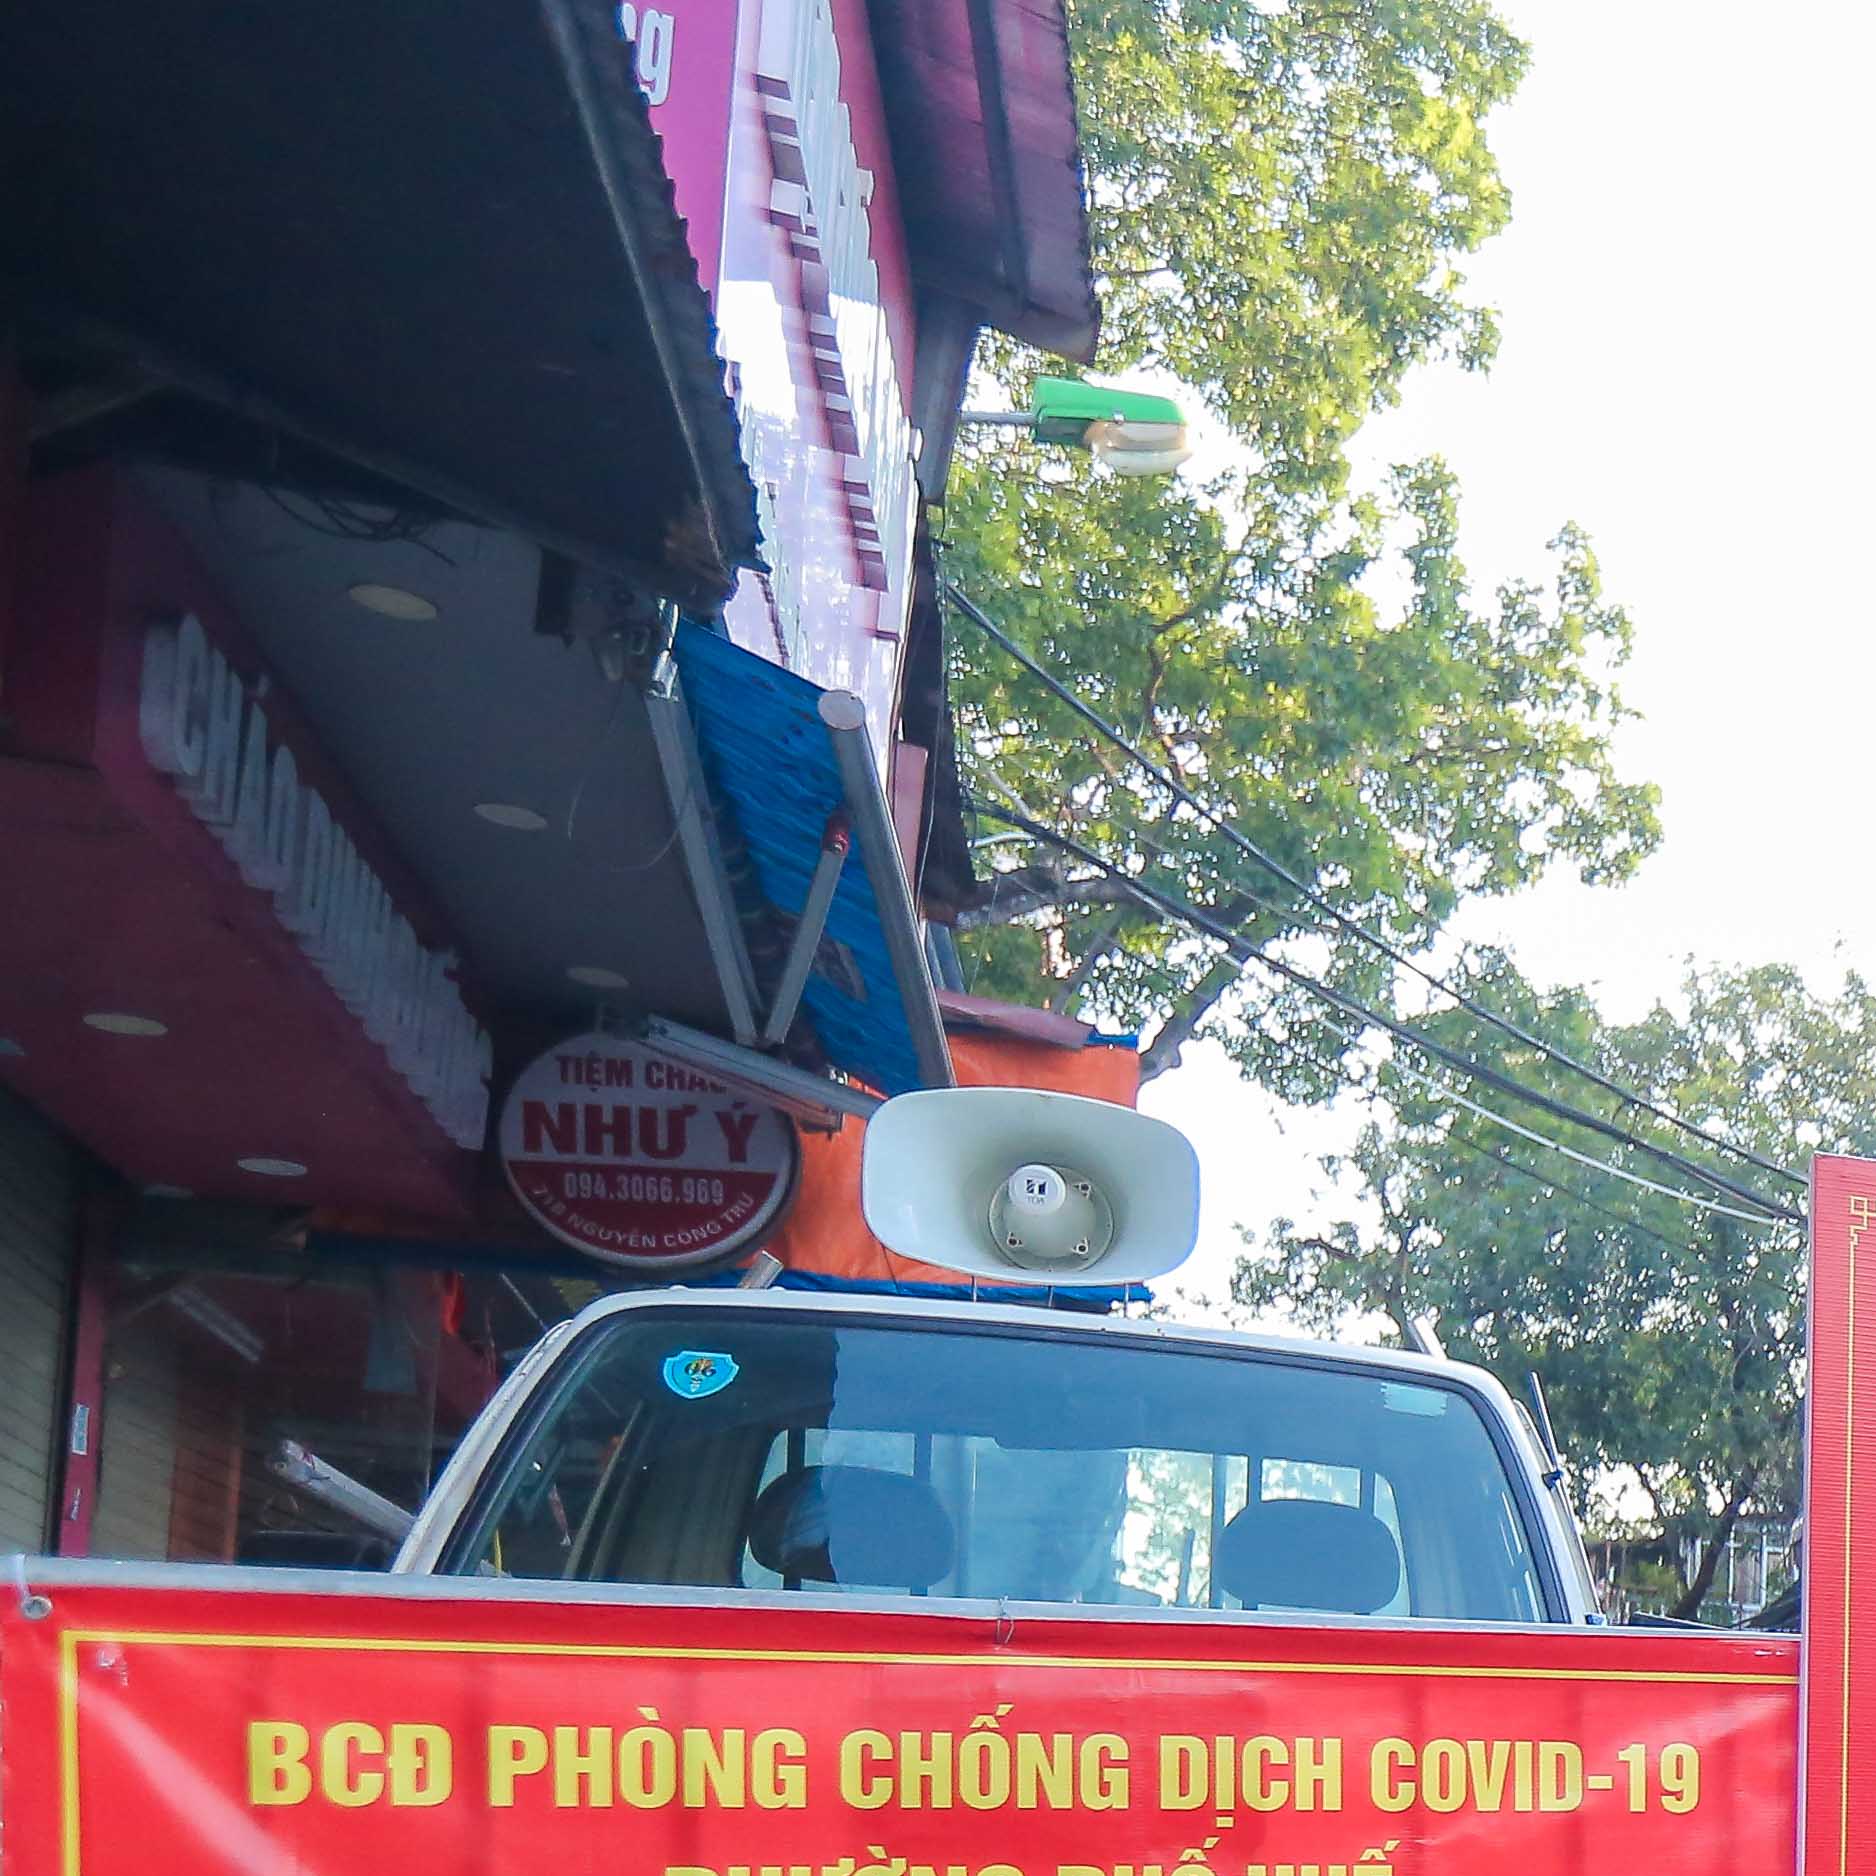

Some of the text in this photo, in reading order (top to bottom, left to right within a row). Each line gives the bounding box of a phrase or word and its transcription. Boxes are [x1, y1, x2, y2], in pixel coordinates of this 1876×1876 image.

[556, 1051, 633, 1092] TIỆM
[522, 1100, 759, 1162] NHƯ Ý
[564, 1172, 724, 1206] 094.3066.969
[247, 1704, 1702, 1828] BCĐ PHÒNG CHỐNG DỊCH COVID-19
